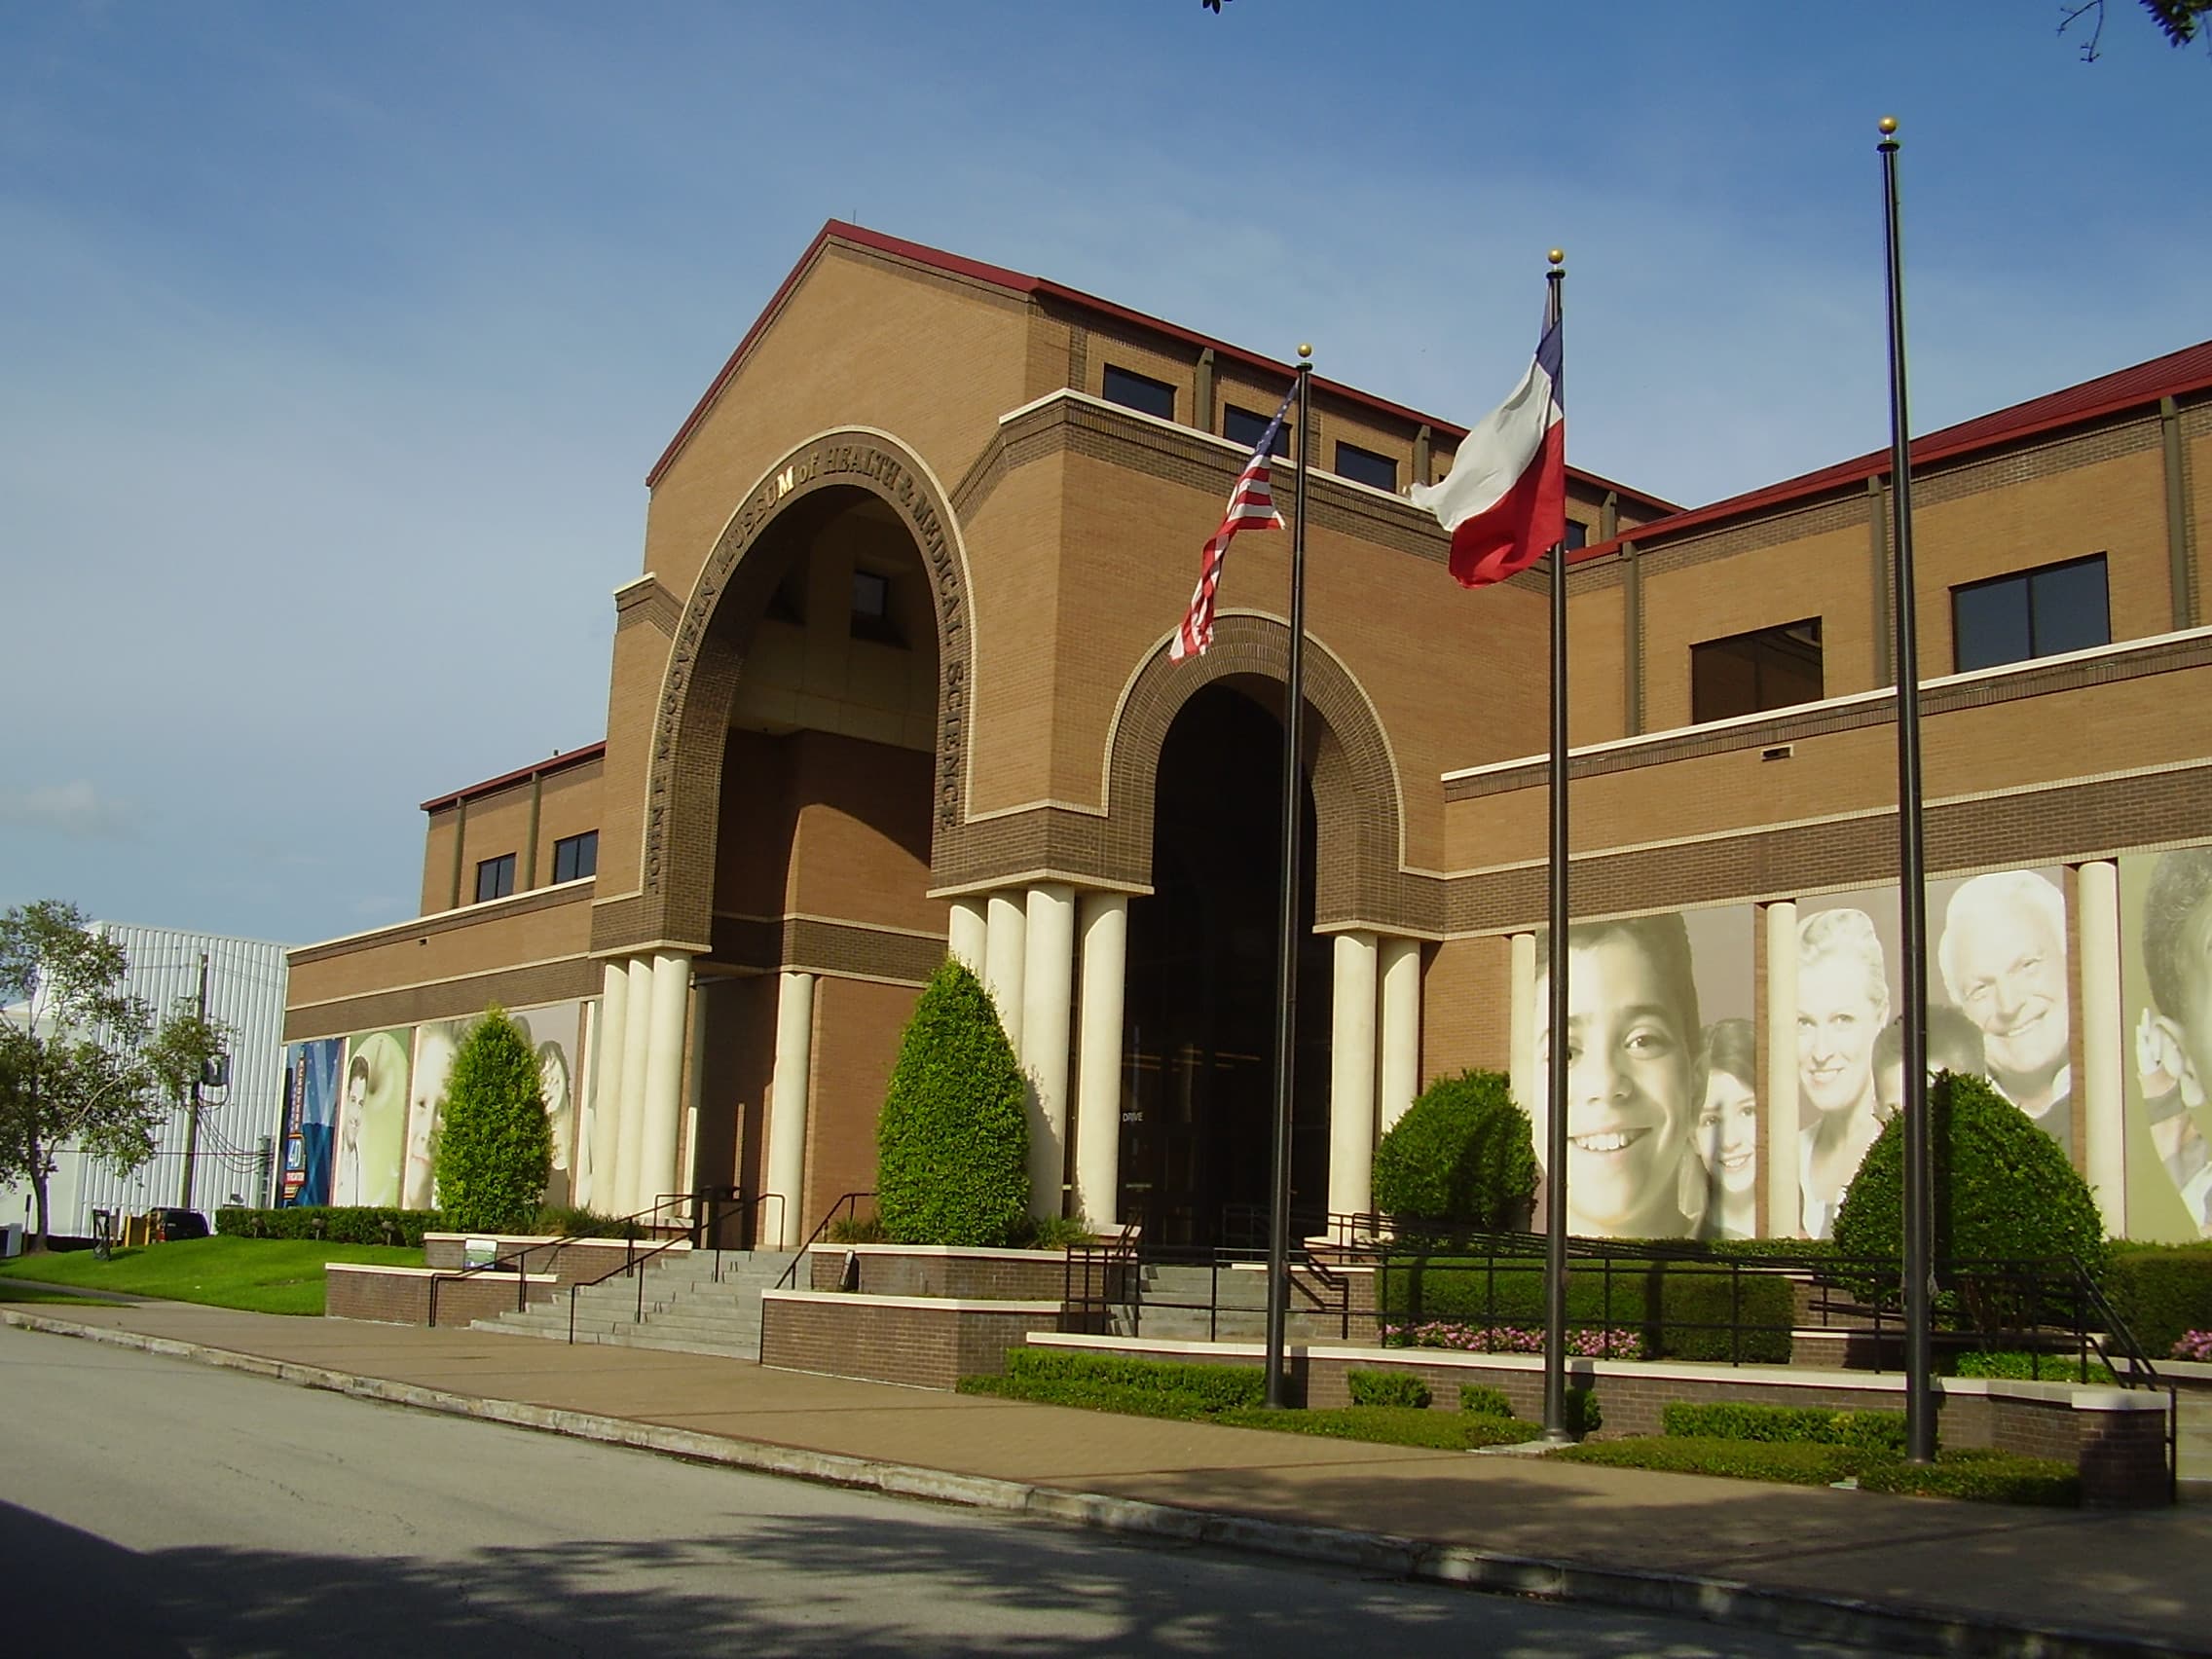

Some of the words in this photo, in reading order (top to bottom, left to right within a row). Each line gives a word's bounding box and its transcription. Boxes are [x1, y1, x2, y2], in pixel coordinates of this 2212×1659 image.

[647, 805, 665, 895] JOHN
[717, 465, 795, 575] MUSEUM
[824, 446, 902, 491] HEALTH
[898, 474, 914, 507] &
[913, 494, 963, 645] MEDICAL
[940, 660, 964, 830] SCIENCE
